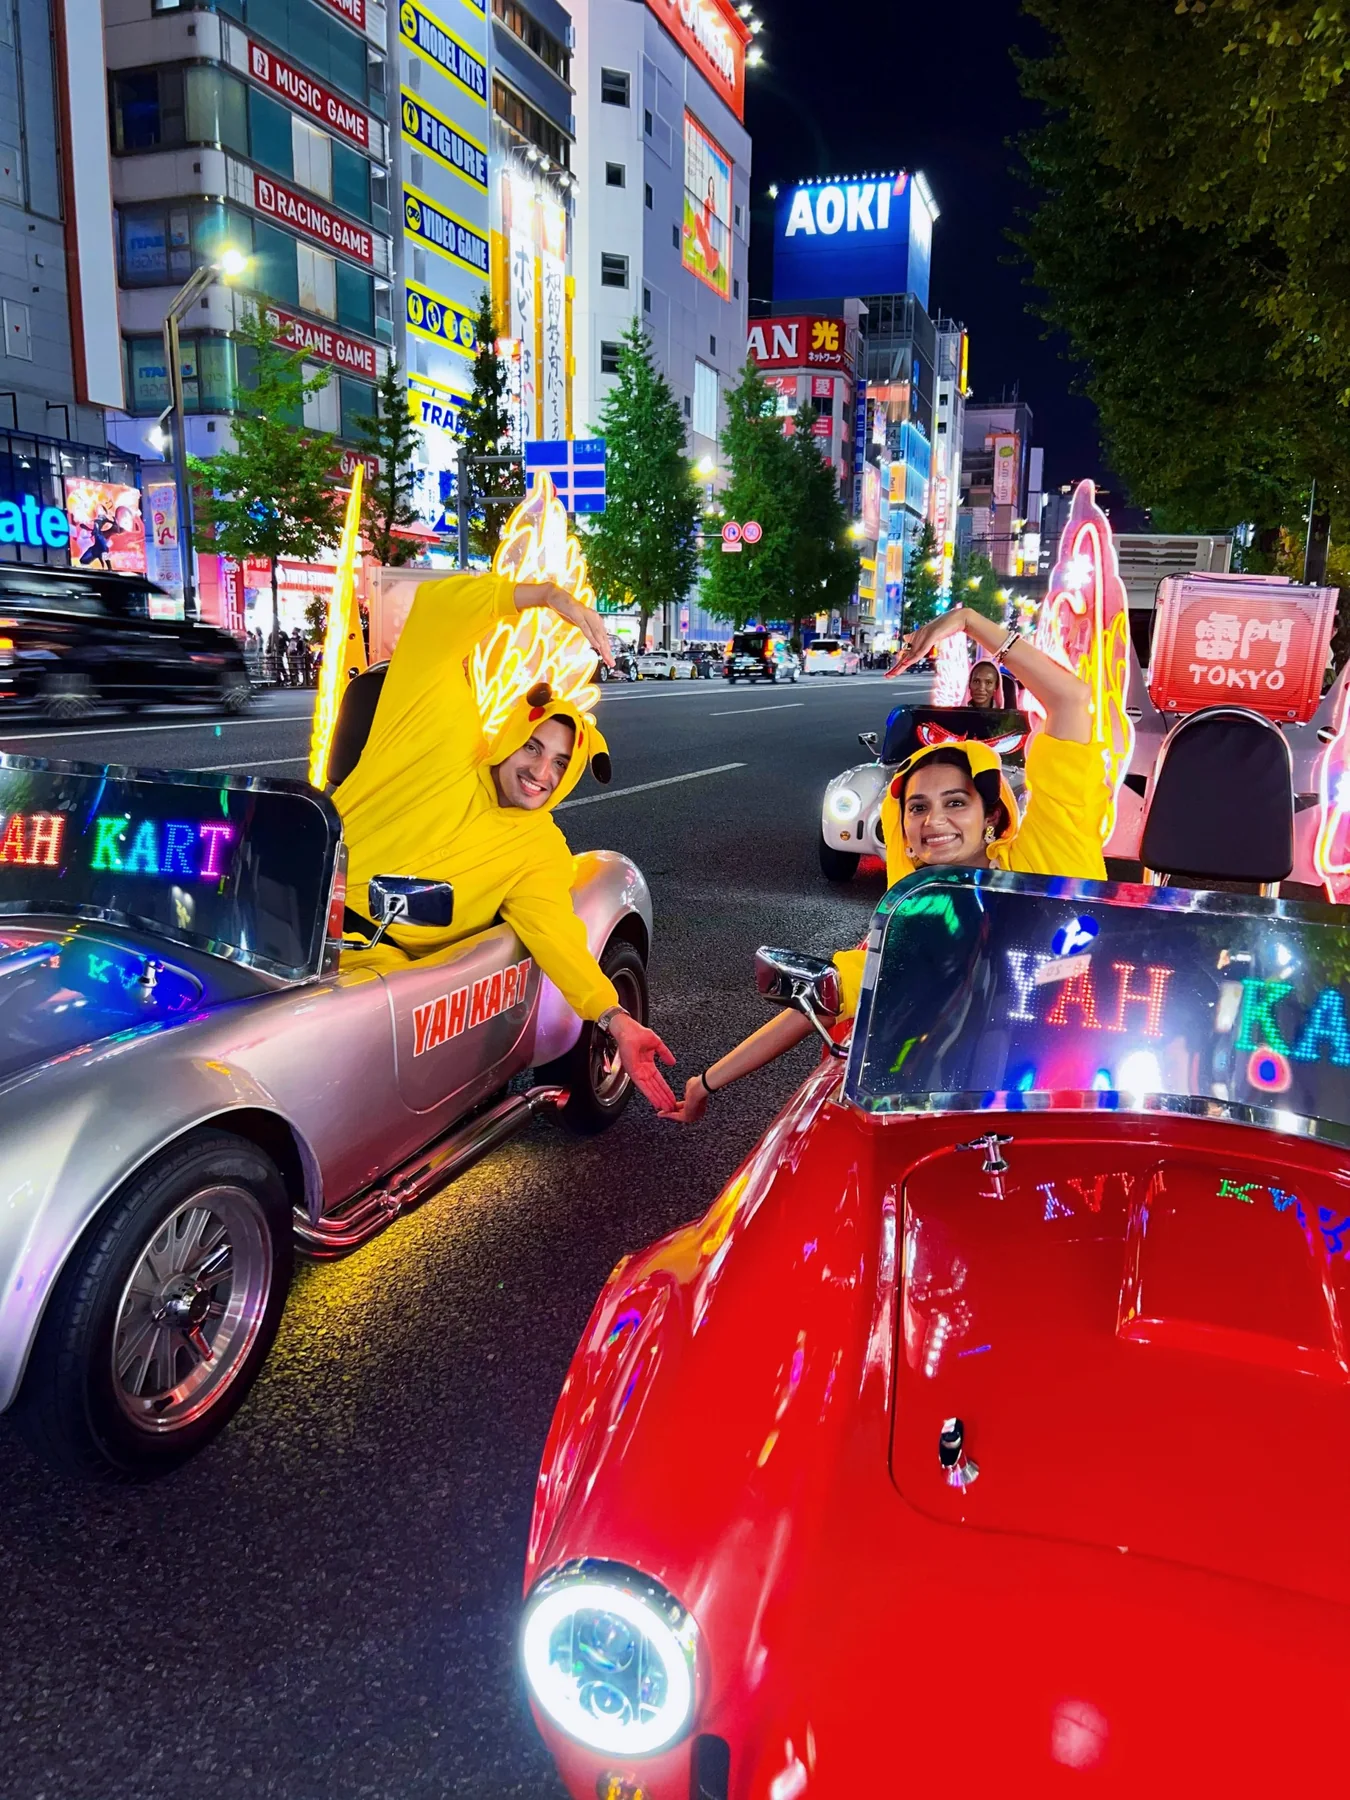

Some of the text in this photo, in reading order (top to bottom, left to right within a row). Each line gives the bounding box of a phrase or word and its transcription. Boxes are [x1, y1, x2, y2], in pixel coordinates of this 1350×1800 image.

[418, 13, 484, 96] MODEL KITS
[275, 62, 365, 141] MUSIC GAME
[421, 110, 486, 184] FIGURE
[276, 190, 369, 258] RACING GAME
[422, 205, 487, 271] VIDEO GAME
[785, 182, 891, 237] AOKI
[285, 319, 373, 373] CRANE GAME
[807, 351, 841, 363] ネットワーク
[811, 320, 839, 352] 光
[340, 455, 376, 481] GAME
[0, 493, 70, 548] ate
[1188, 663, 1286, 691] TOKYO
[90, 816, 234, 876] KART
[412, 957, 532, 1058] YAH KART
[1006, 948, 1176, 1038] YAH
